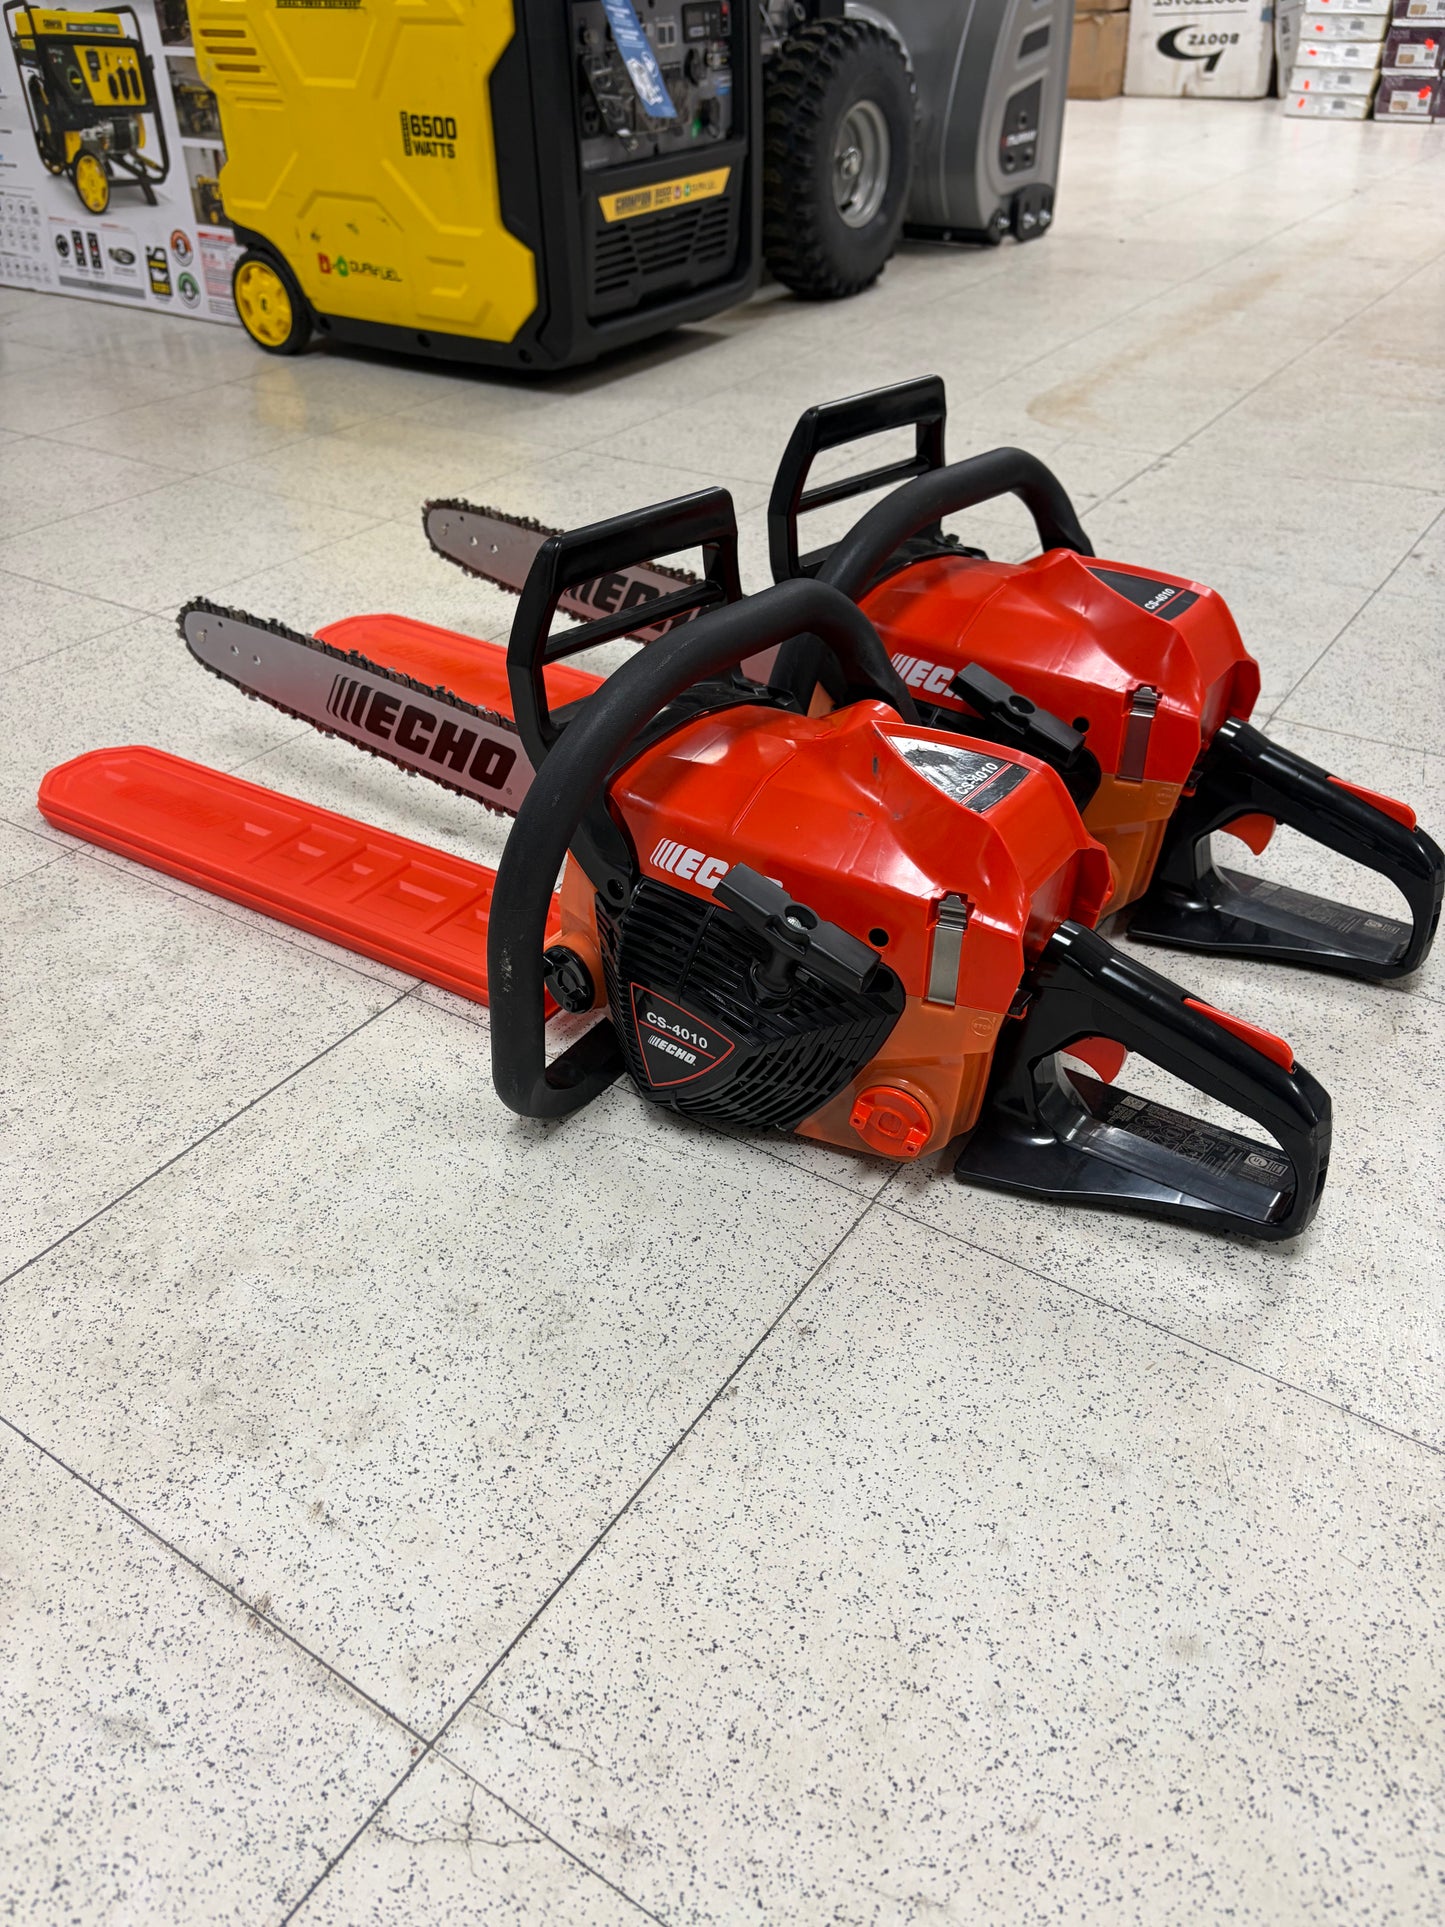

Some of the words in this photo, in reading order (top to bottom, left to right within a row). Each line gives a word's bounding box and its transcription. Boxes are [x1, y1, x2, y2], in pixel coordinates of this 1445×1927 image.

[1188, 33, 1240, 46] BOOTZ
[410, 114, 457, 140] 6500
[413, 141, 456, 159] WATTS
[1144, 588, 1175, 610] CS-4010
[364, 690, 517, 790] ECHO
[955, 762, 999, 795] CS-4010
[646, 1011, 708, 1049] CS-4010
[657, 1037, 697, 1065] ECHO
